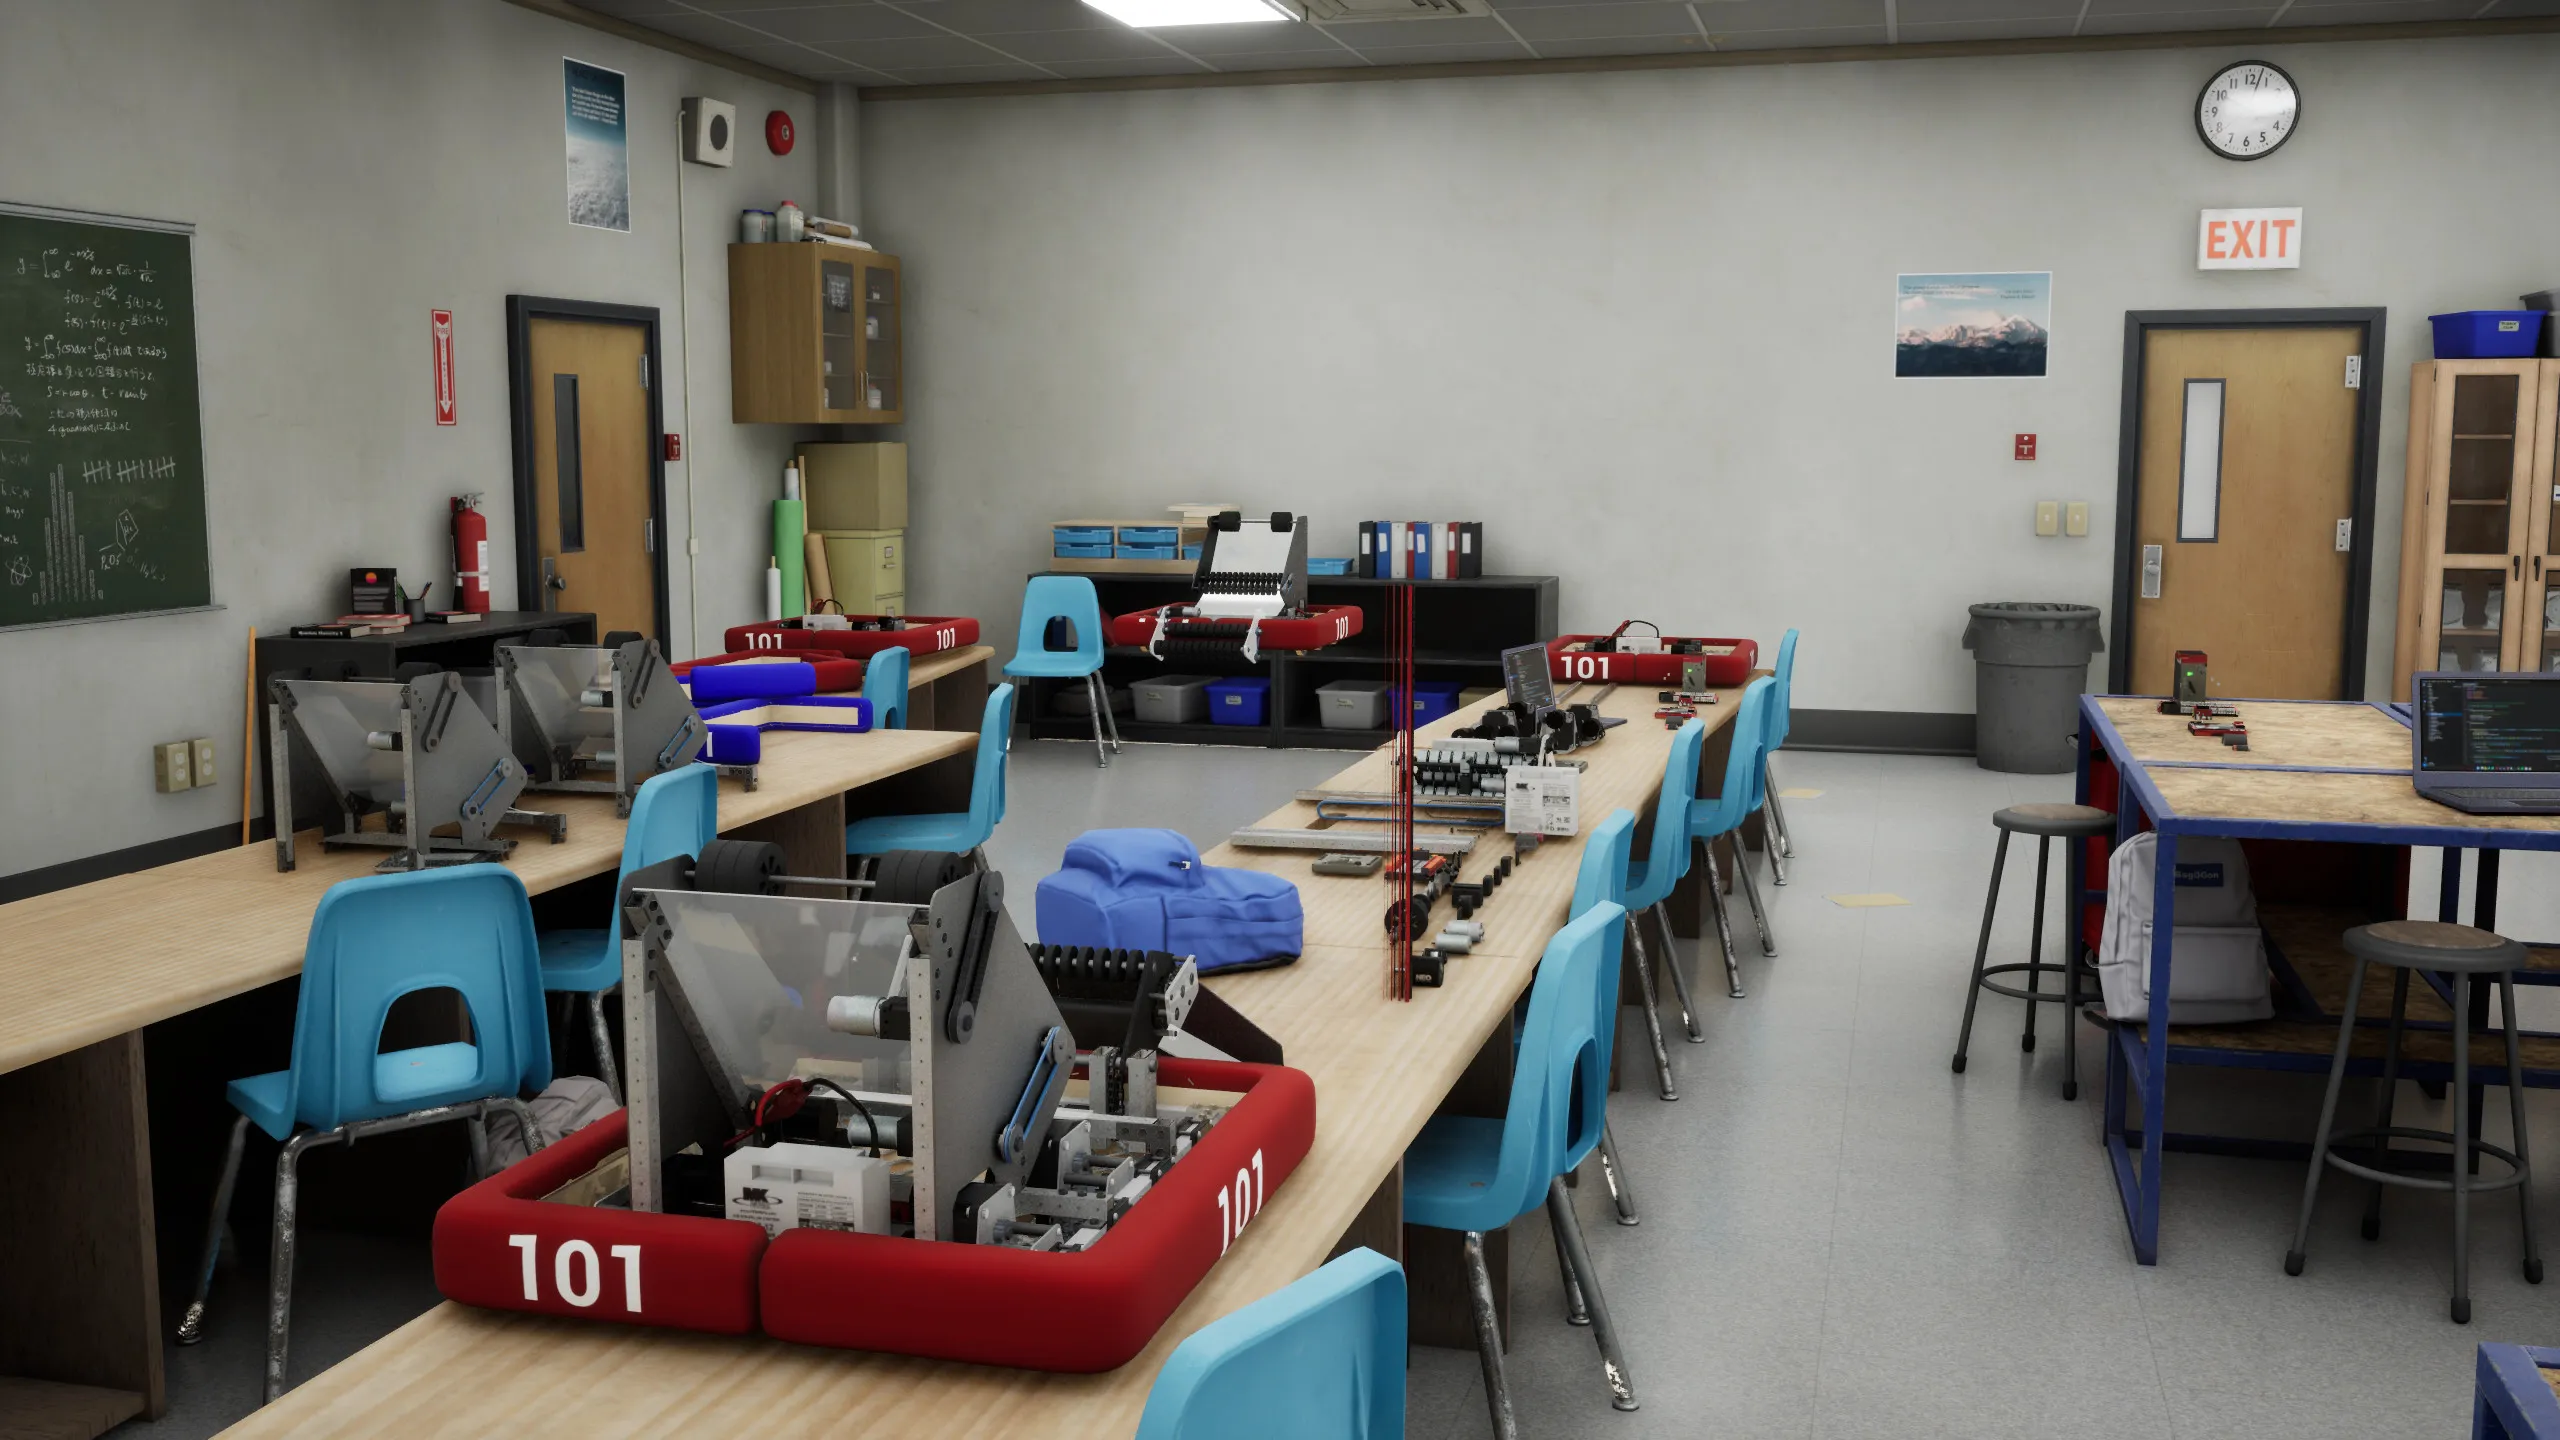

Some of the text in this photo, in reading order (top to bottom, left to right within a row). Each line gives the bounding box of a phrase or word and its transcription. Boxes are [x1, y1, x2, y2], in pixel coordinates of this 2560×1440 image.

[2229, 78, 2238, 89] 11
[2245, 74, 2256, 85] 12
[2264, 77, 2268, 88] 1
[2216, 90, 2227, 101] 10
[2211, 106, 2218, 117] 9
[2216, 121, 2223, 133] 8
[2272, 120, 2280, 131] 4
[2228, 132, 2235, 143] 7
[2243, 136, 2250, 147] 6
[2259, 131, 2266, 143] 5
[2206, 219, 2296, 259] EXIT
[437, 327, 449, 335] FIRE
[1335, 615, 1349, 641] 101
[745, 633, 783, 649] 101
[936, 627, 956, 651] 101
[1561, 656, 1609, 680] 101
[1415, 973, 1432, 983] NEO
[1217, 1147, 1263, 1259] 101
[508, 1234, 642, 1313] 101
